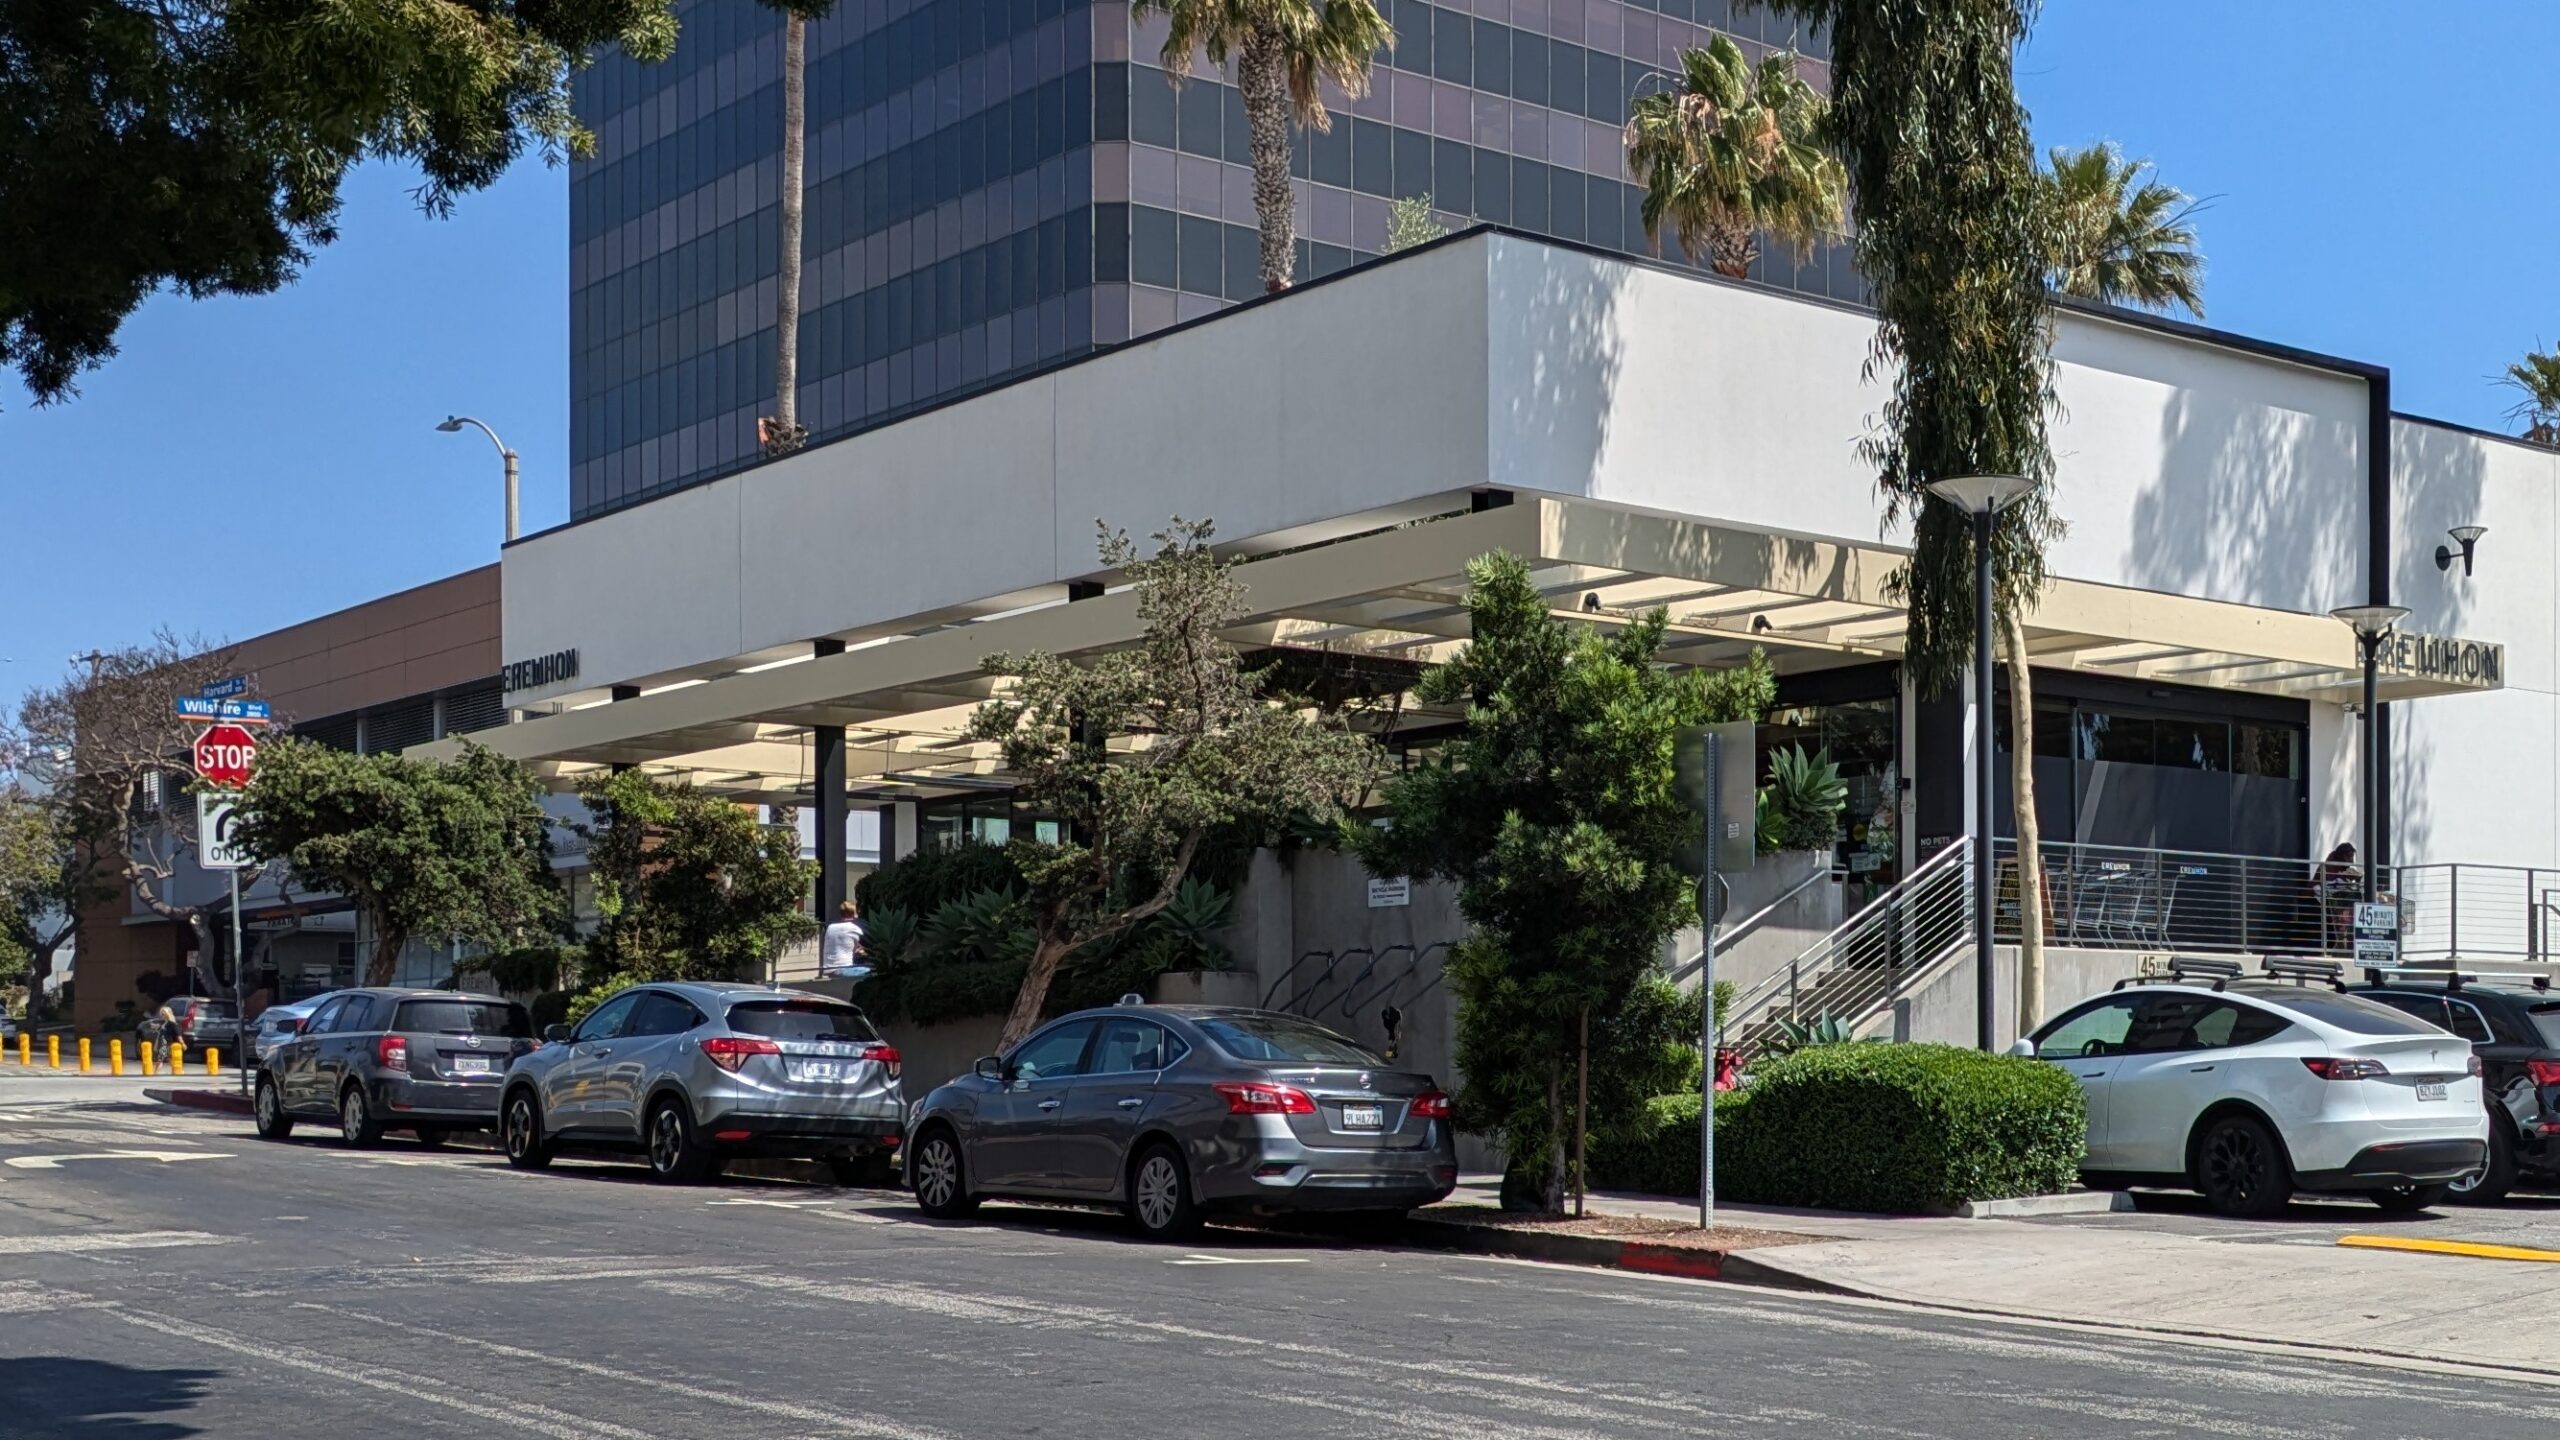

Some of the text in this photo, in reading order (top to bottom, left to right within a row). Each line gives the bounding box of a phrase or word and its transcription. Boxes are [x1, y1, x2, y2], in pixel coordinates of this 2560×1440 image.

[2360, 633, 2499, 681] REWHON
[501, 648, 577, 692] EREWHON
[203, 680, 233, 698] Harvard
[184, 700, 242, 715] Wilshire
[200, 745, 256, 769] STOP
[1920, 836, 1951, 846] NO PETS
[211, 847, 247, 861] ONL
[2358, 905, 2394, 926] 45 MINUTE
[2140, 955, 2156, 977] 45
